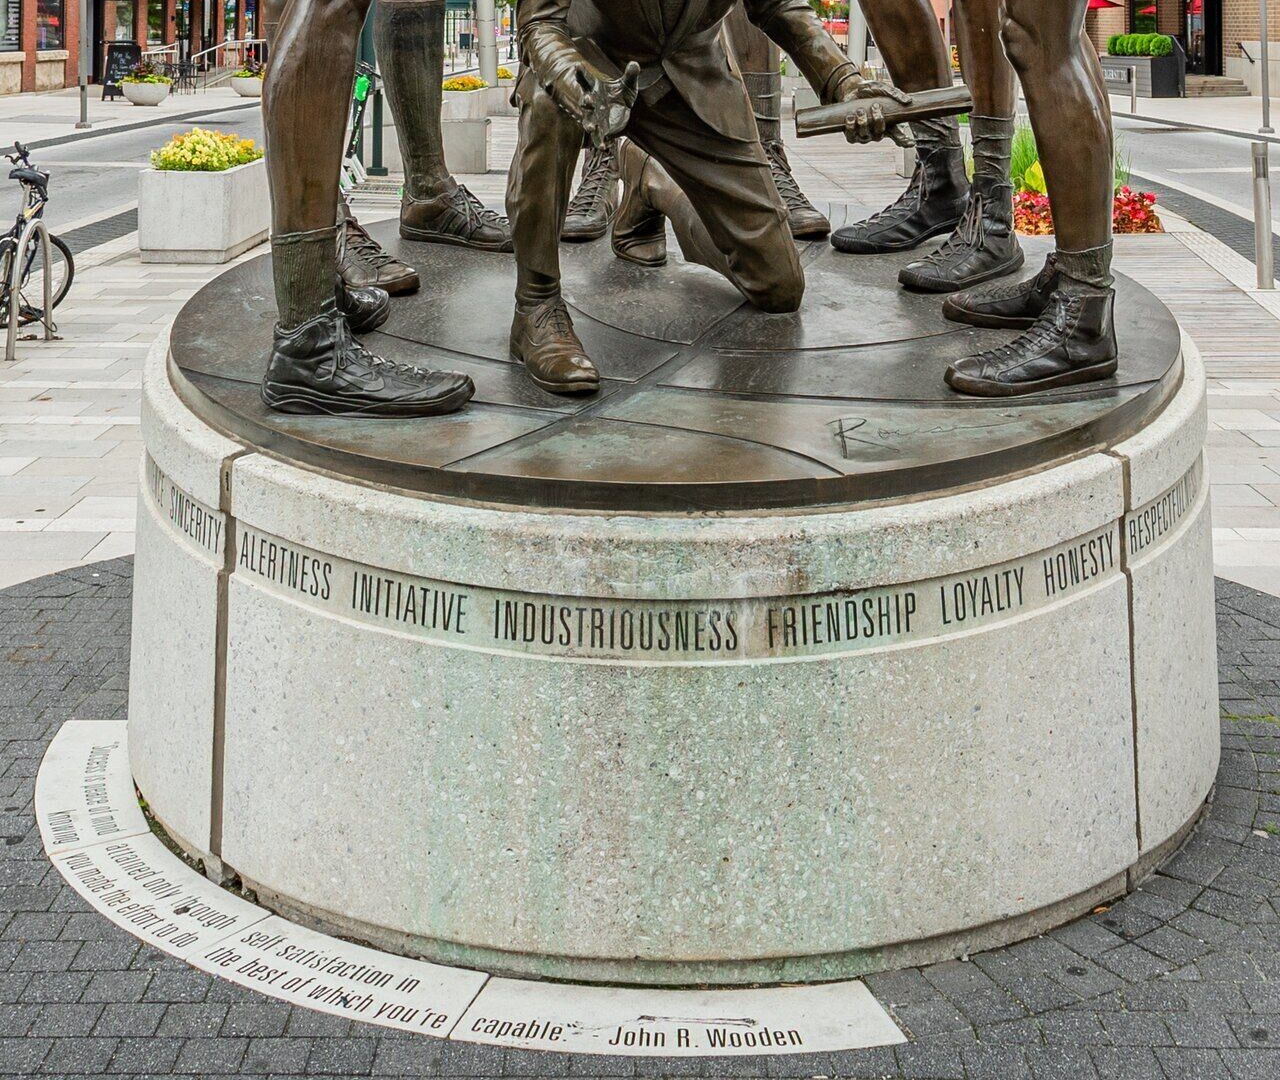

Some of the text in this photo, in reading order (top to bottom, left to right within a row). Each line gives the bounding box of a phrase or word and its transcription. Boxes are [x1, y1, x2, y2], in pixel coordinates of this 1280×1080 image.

[169, 485, 222, 555] SINCERITY
[240, 530, 1114, 652] ALERTNESS INITIATIVE INDUSTRIOUSNESS FRIENDSHIP LOYALTY HONESTY
[81, 783, 109, 805] peace
[88, 806, 119, 815] of
[48, 808, 80, 845] knowing
[91, 815, 127, 836] mind
[60, 851, 93, 871] you
[106, 843, 158, 881] attained
[75, 867, 116, 893] made
[143, 877, 184, 901] only
[99, 888, 131, 907] the
[116, 904, 164, 930] effort
[170, 894, 239, 930] through
[151, 922, 179, 938] to
[169, 931, 199, 948] do
[241, 931, 284, 952] self
[204, 946, 242, 968] the
[275, 943, 395, 988] satisfaction
[236, 957, 287, 985] best
[281, 976, 311, 994] of
[395, 974, 421, 994] in
[307, 982, 374, 1013] which
[372, 1001, 448, 1030] you're
[608, 1025, 665, 1047] John
[677, 1027, 698, 1048] R.
[706, 1026, 803, 1047] Wooden
